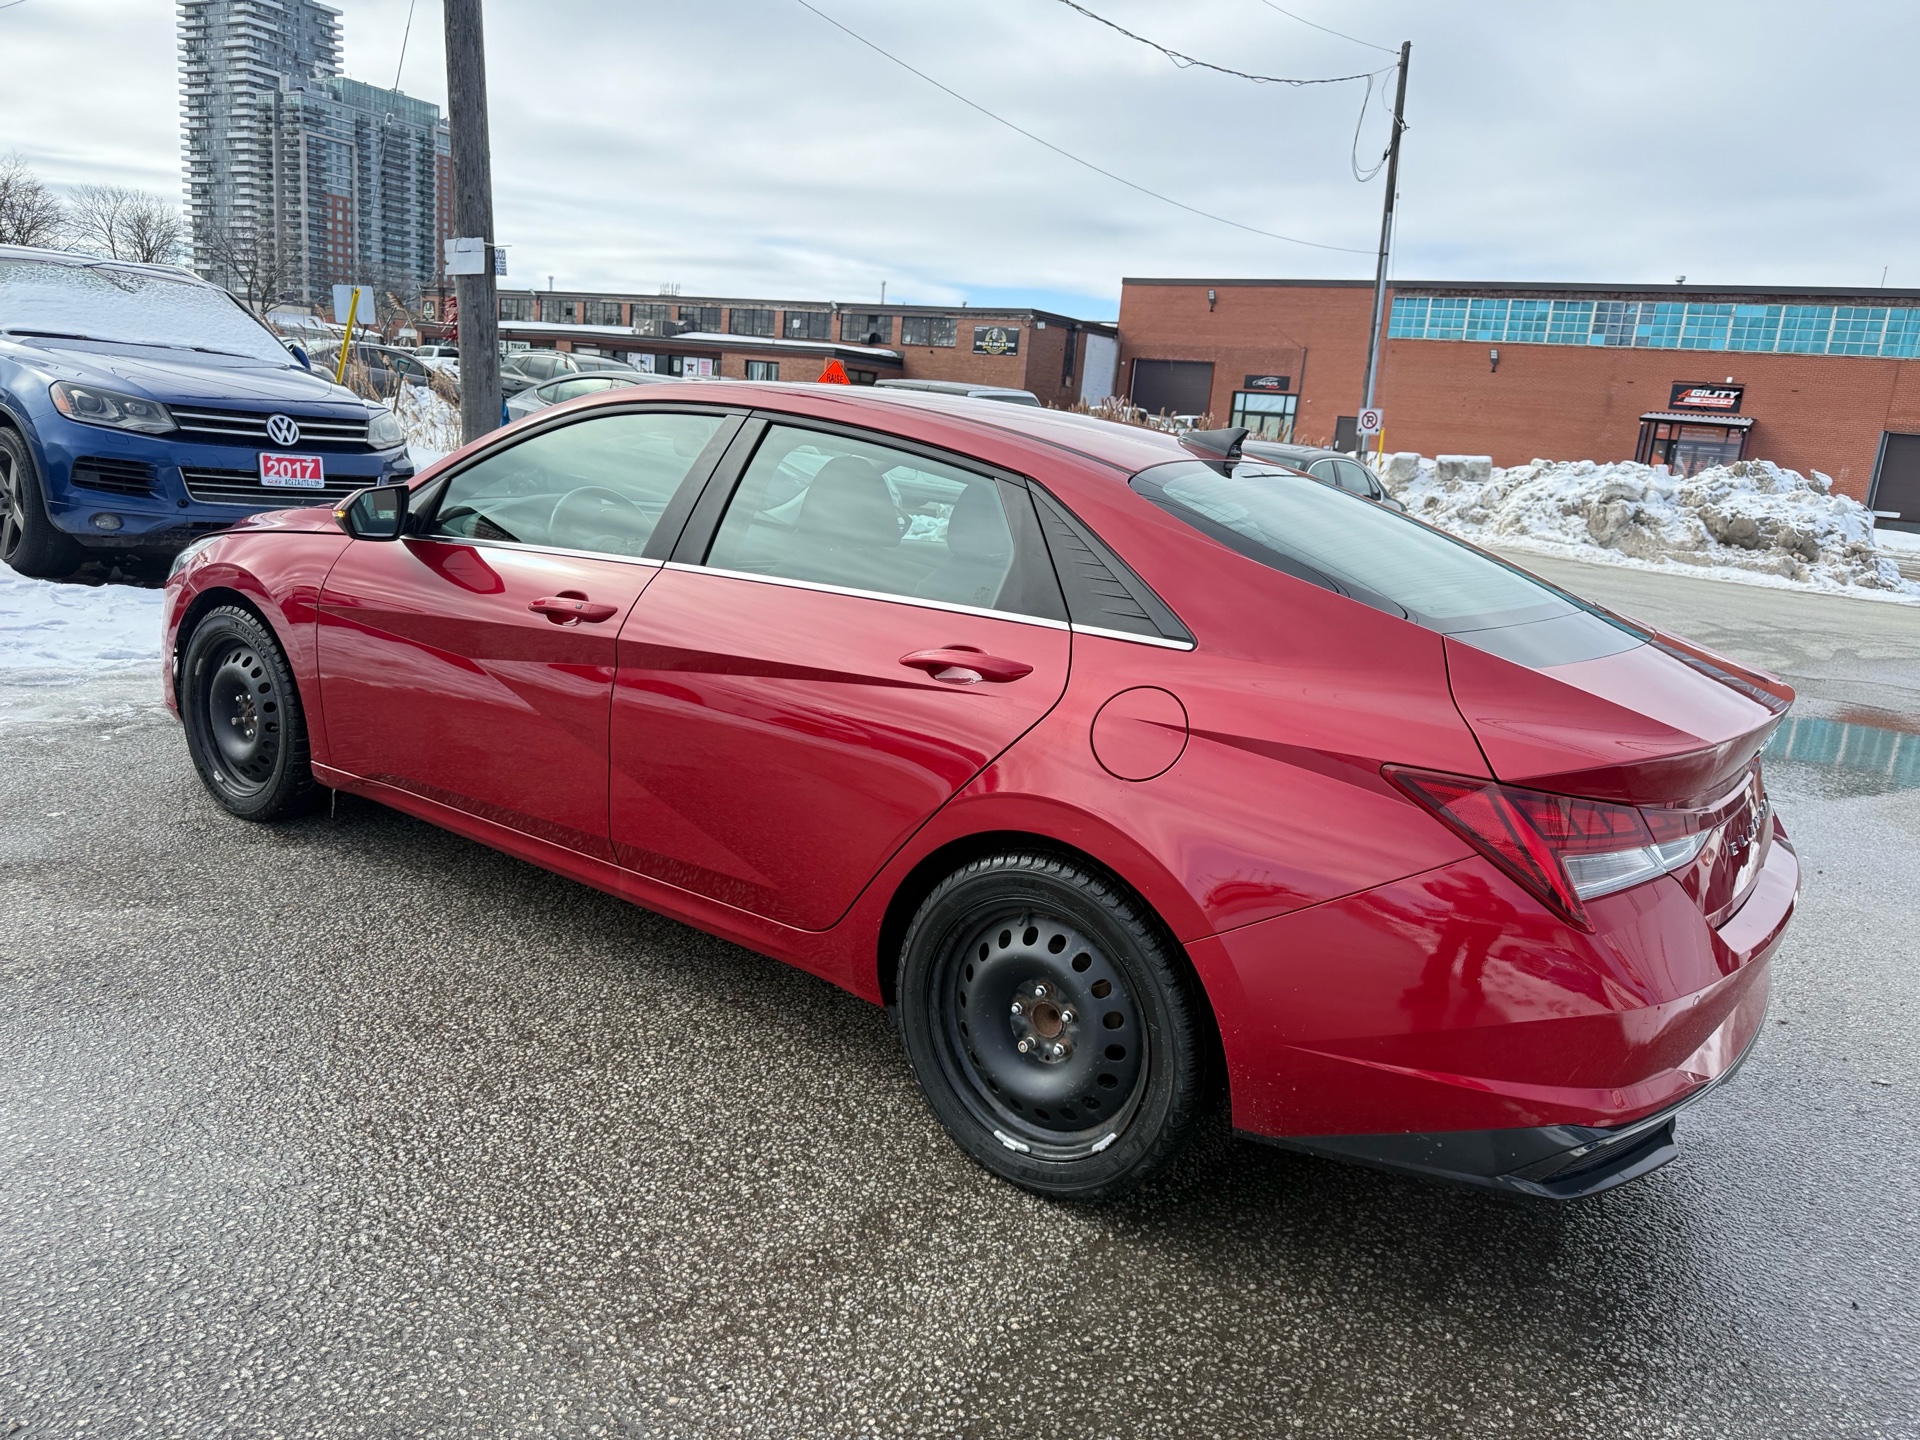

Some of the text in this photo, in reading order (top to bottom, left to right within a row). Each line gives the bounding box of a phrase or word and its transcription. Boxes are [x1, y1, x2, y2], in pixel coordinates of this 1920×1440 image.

[826, 373, 844, 384] RAISE
[1677, 389, 1740, 400] AGILITY
[267, 460, 315, 479] 2017
